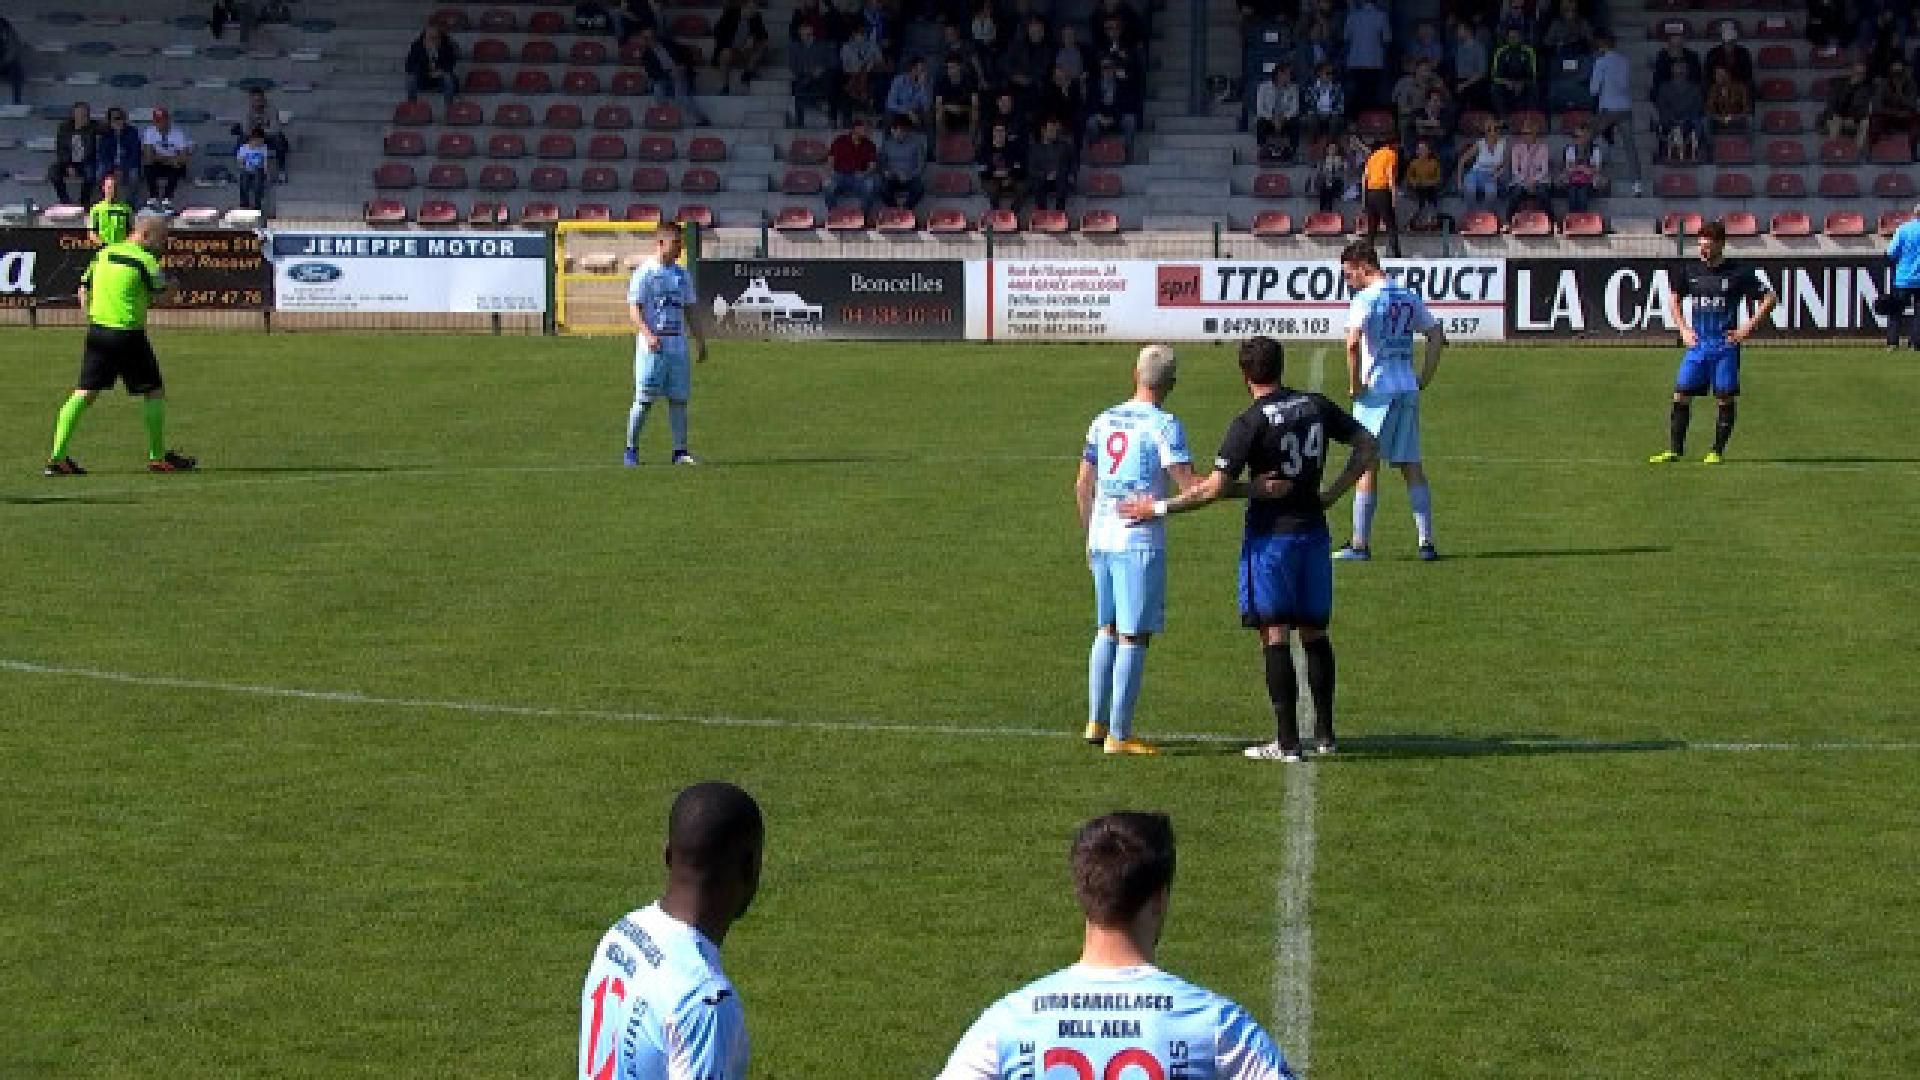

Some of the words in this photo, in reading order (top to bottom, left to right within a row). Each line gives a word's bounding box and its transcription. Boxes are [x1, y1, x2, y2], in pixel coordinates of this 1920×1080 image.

[302, 239, 418, 255] JEMEPPE
[428, 239, 514, 256] MOTOR
[851, 272, 943, 292] Boncelles
[1160, 275, 1199, 302] sprl
[1217, 266, 1279, 301] TTP
[1286, 266, 1498, 301] CONTRUCT
[1516, 269, 1585, 331] LA
[1106, 431, 1128, 475] 9
[1280, 422, 1324, 477] 34
